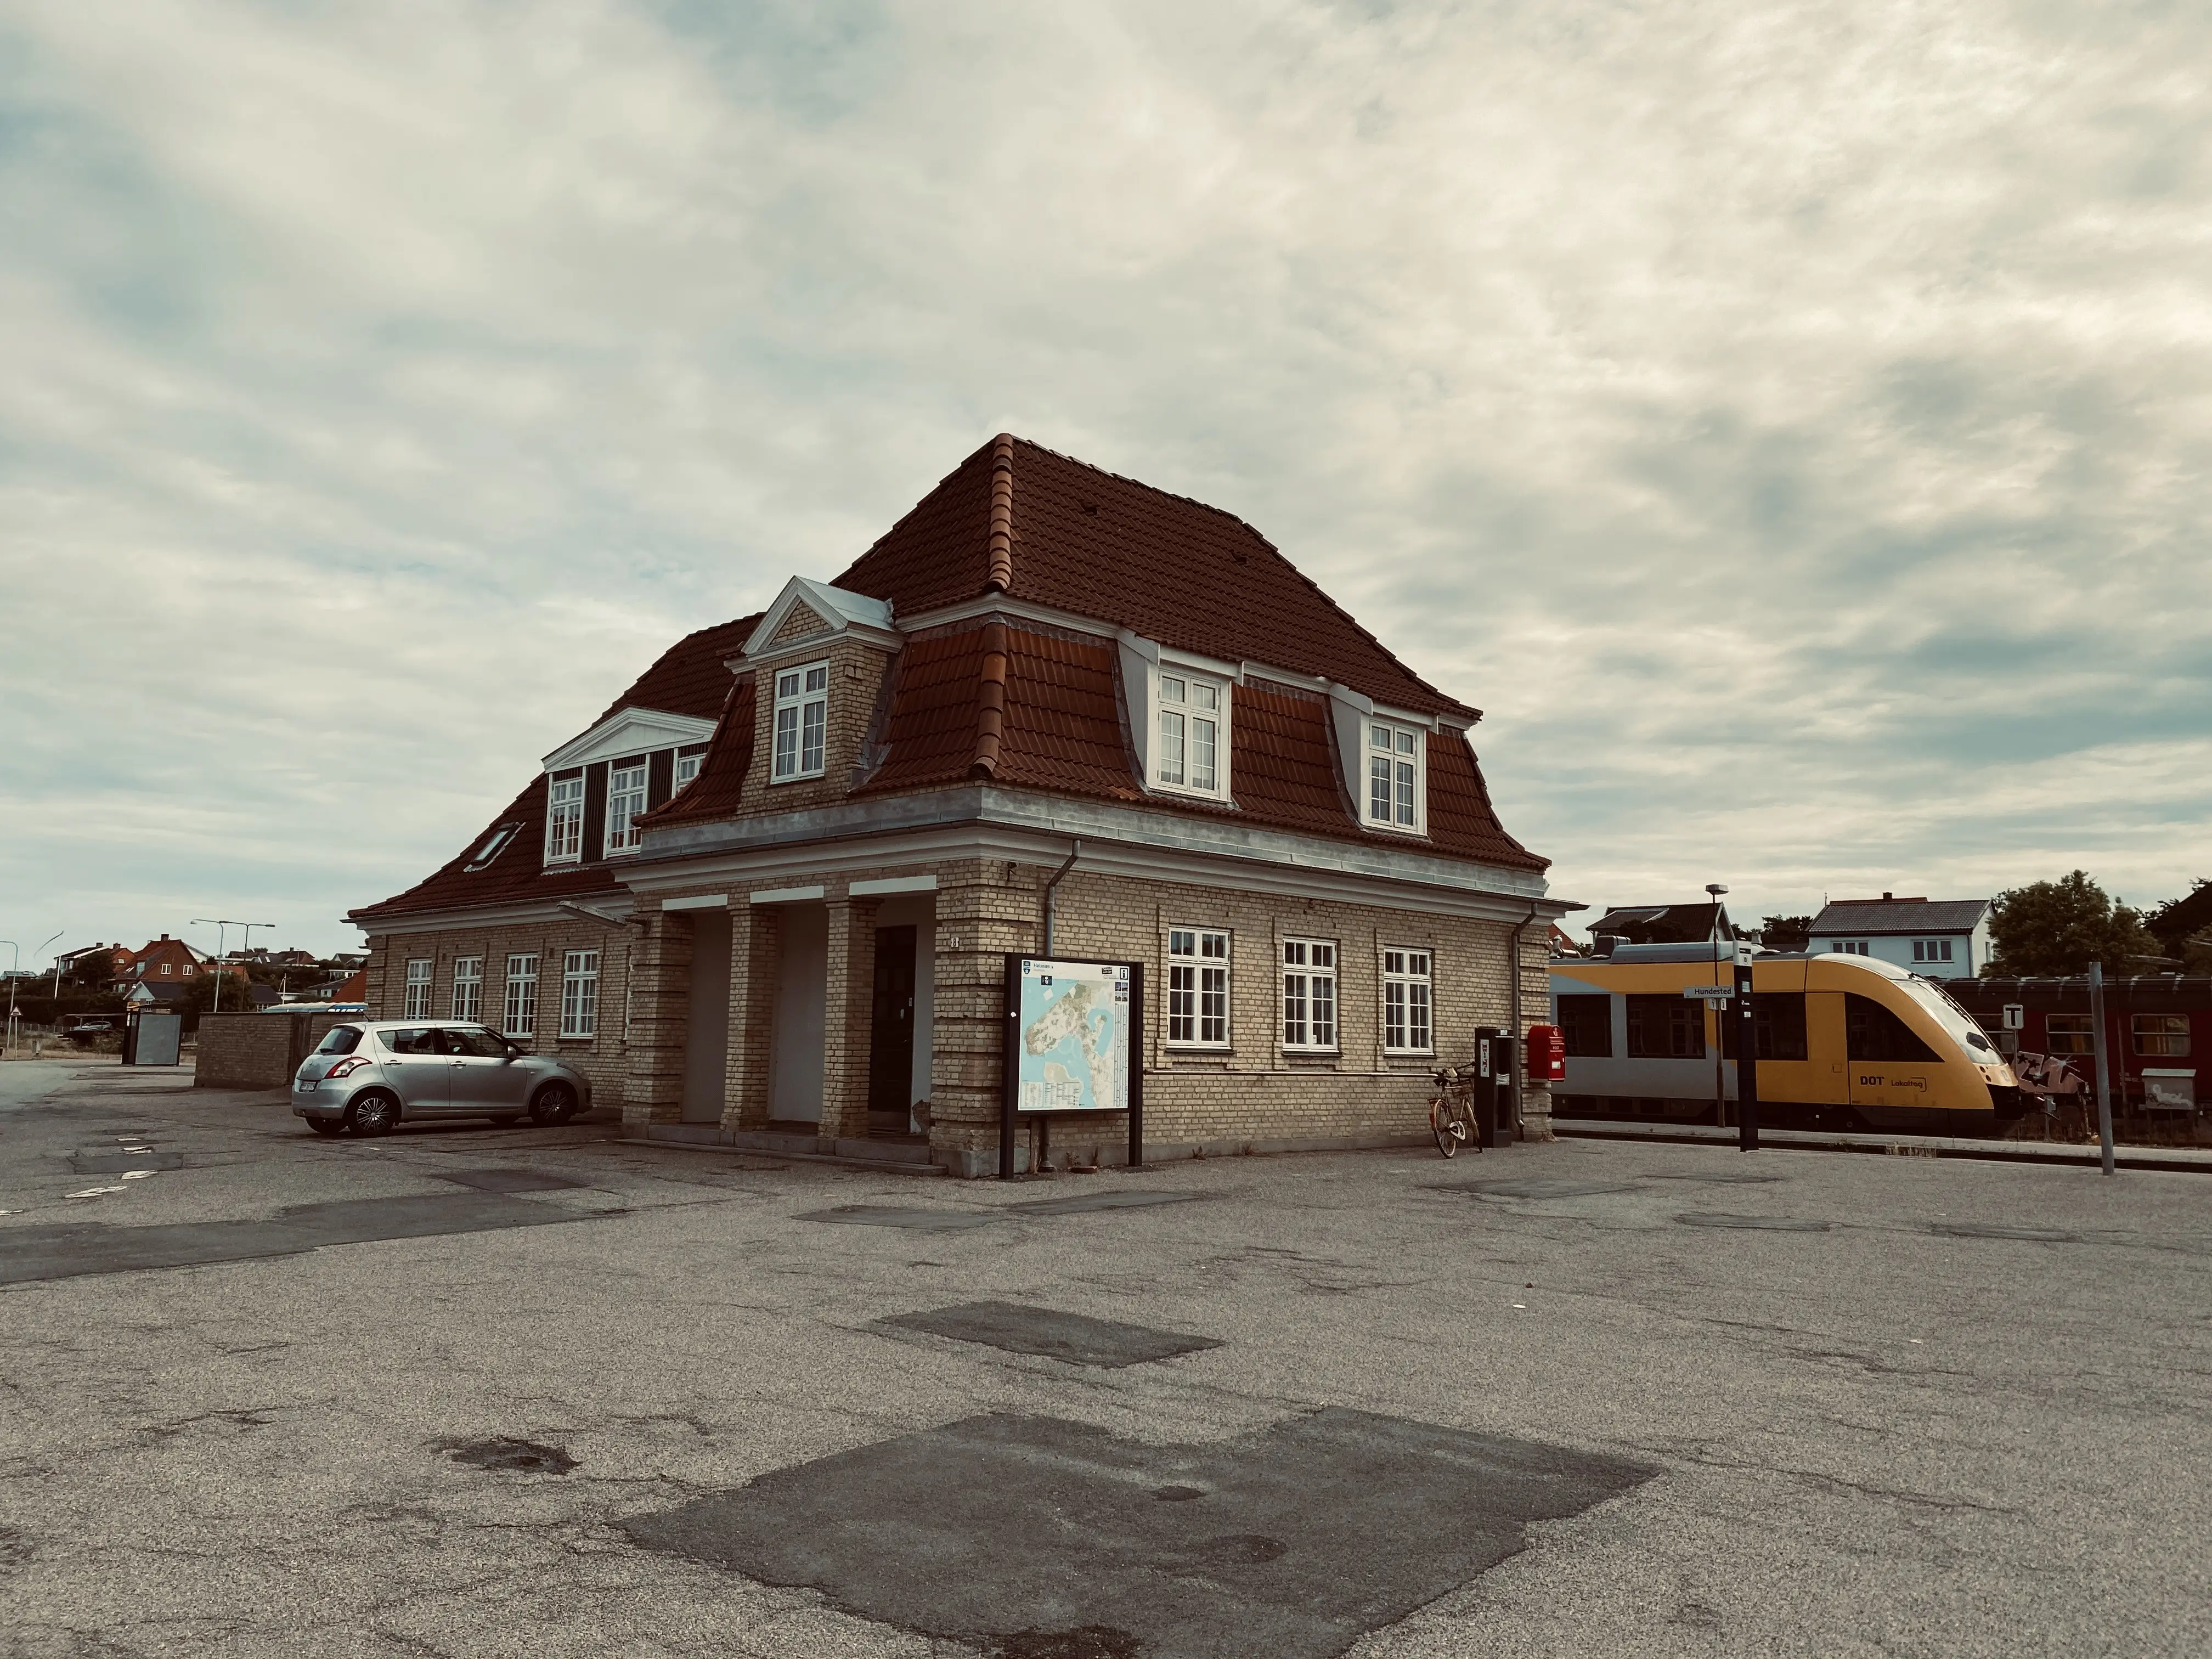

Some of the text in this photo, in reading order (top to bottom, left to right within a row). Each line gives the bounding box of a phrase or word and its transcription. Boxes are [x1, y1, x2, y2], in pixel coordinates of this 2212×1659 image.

[953, 938, 957, 947] 8
[2005, 1007, 2021, 1026] T
[1860, 1076, 1923, 1088] DOT Lokaltog
